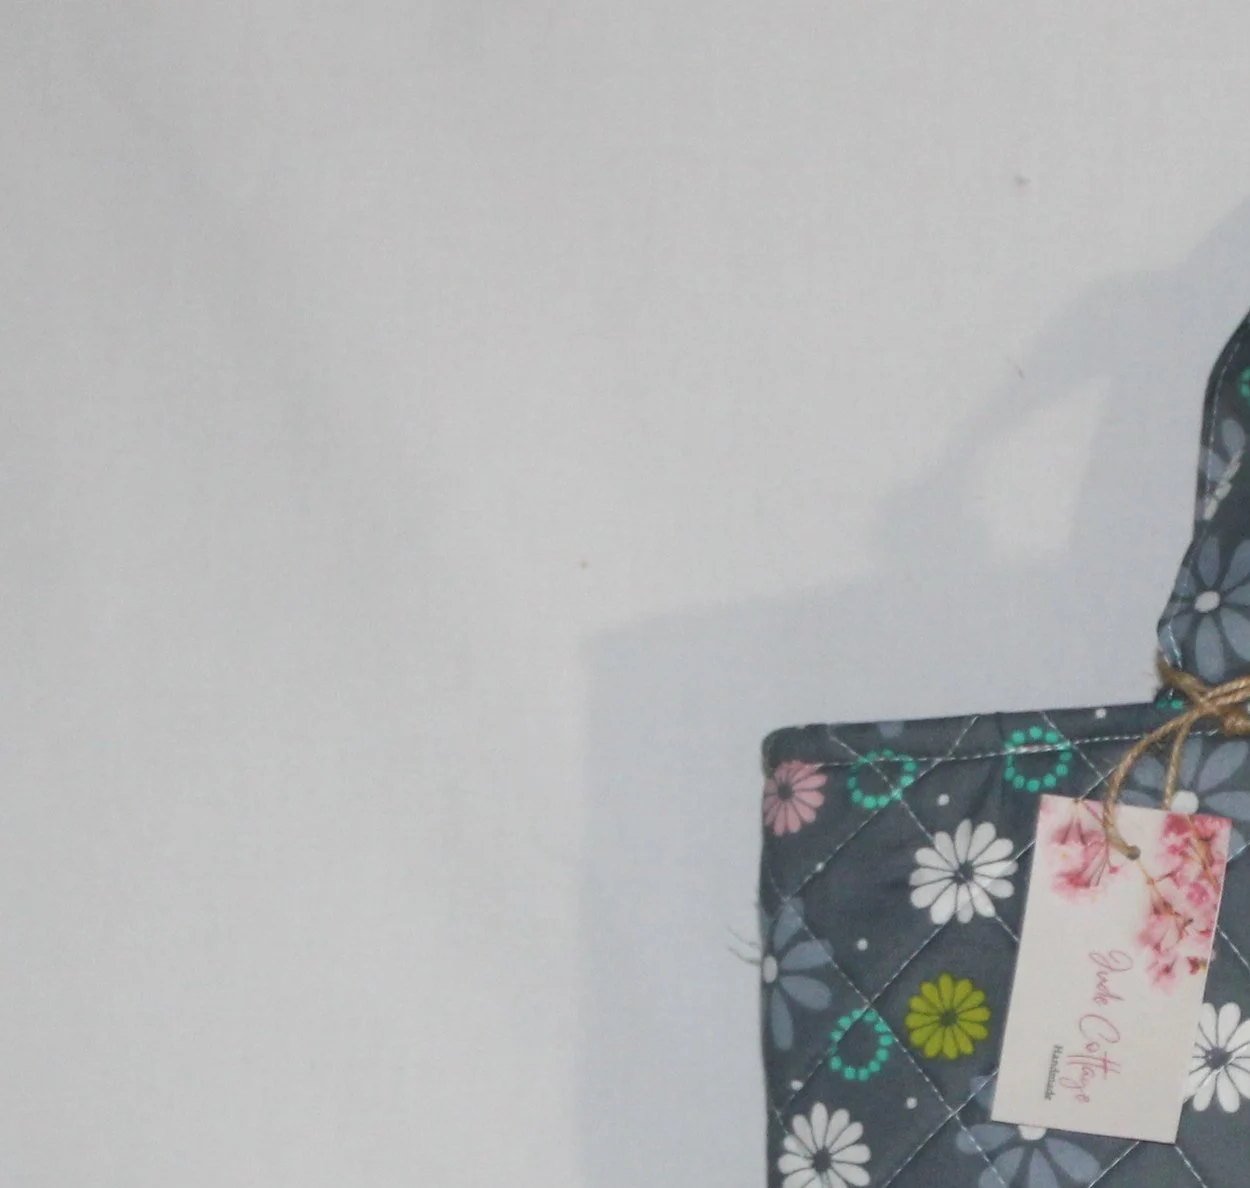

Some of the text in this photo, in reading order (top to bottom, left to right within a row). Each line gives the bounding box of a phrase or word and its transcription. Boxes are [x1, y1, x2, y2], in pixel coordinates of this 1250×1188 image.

[1044, 1044, 1064, 1101] Handmade
[1059, 950, 1134, 1102] Jude Cottage
